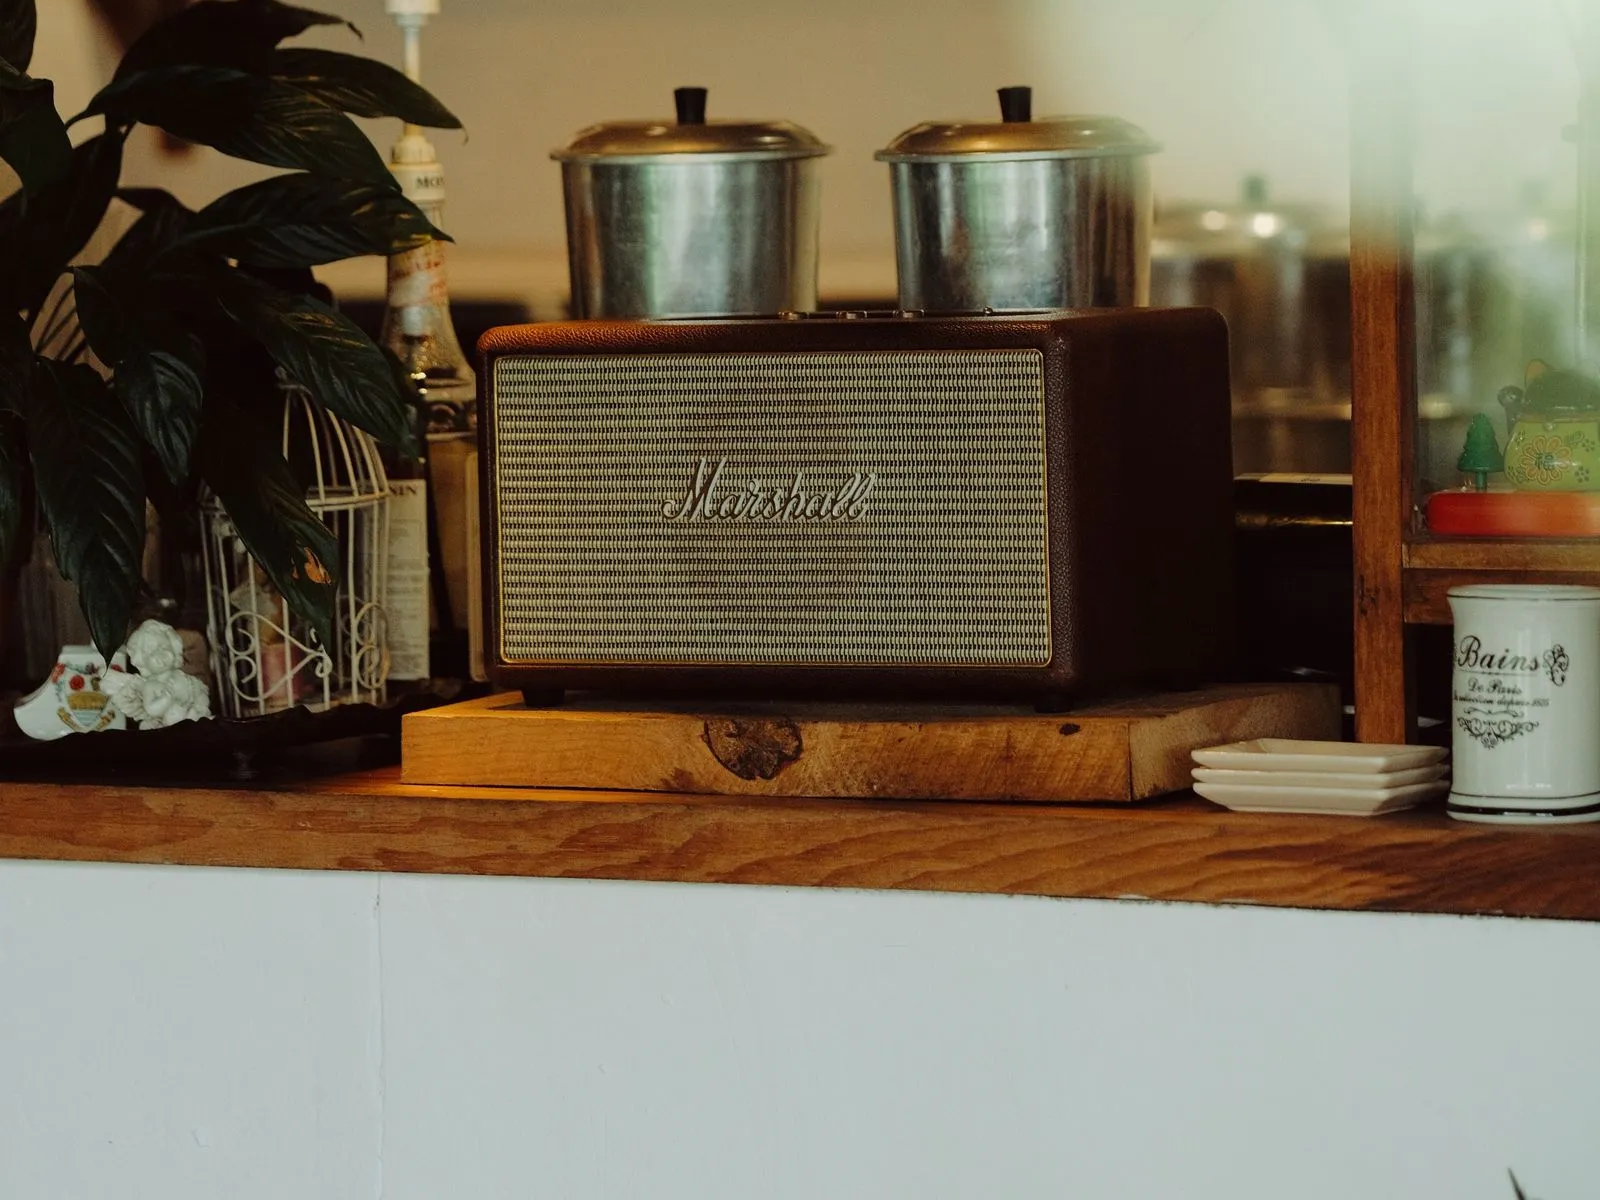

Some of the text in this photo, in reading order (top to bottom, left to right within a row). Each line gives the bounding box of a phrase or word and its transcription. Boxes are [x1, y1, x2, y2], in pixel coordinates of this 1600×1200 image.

[662, 457, 876, 522] Marshall
[1457, 635, 1541, 671] Bains
[1468, 677, 1522, 695] De Paris
